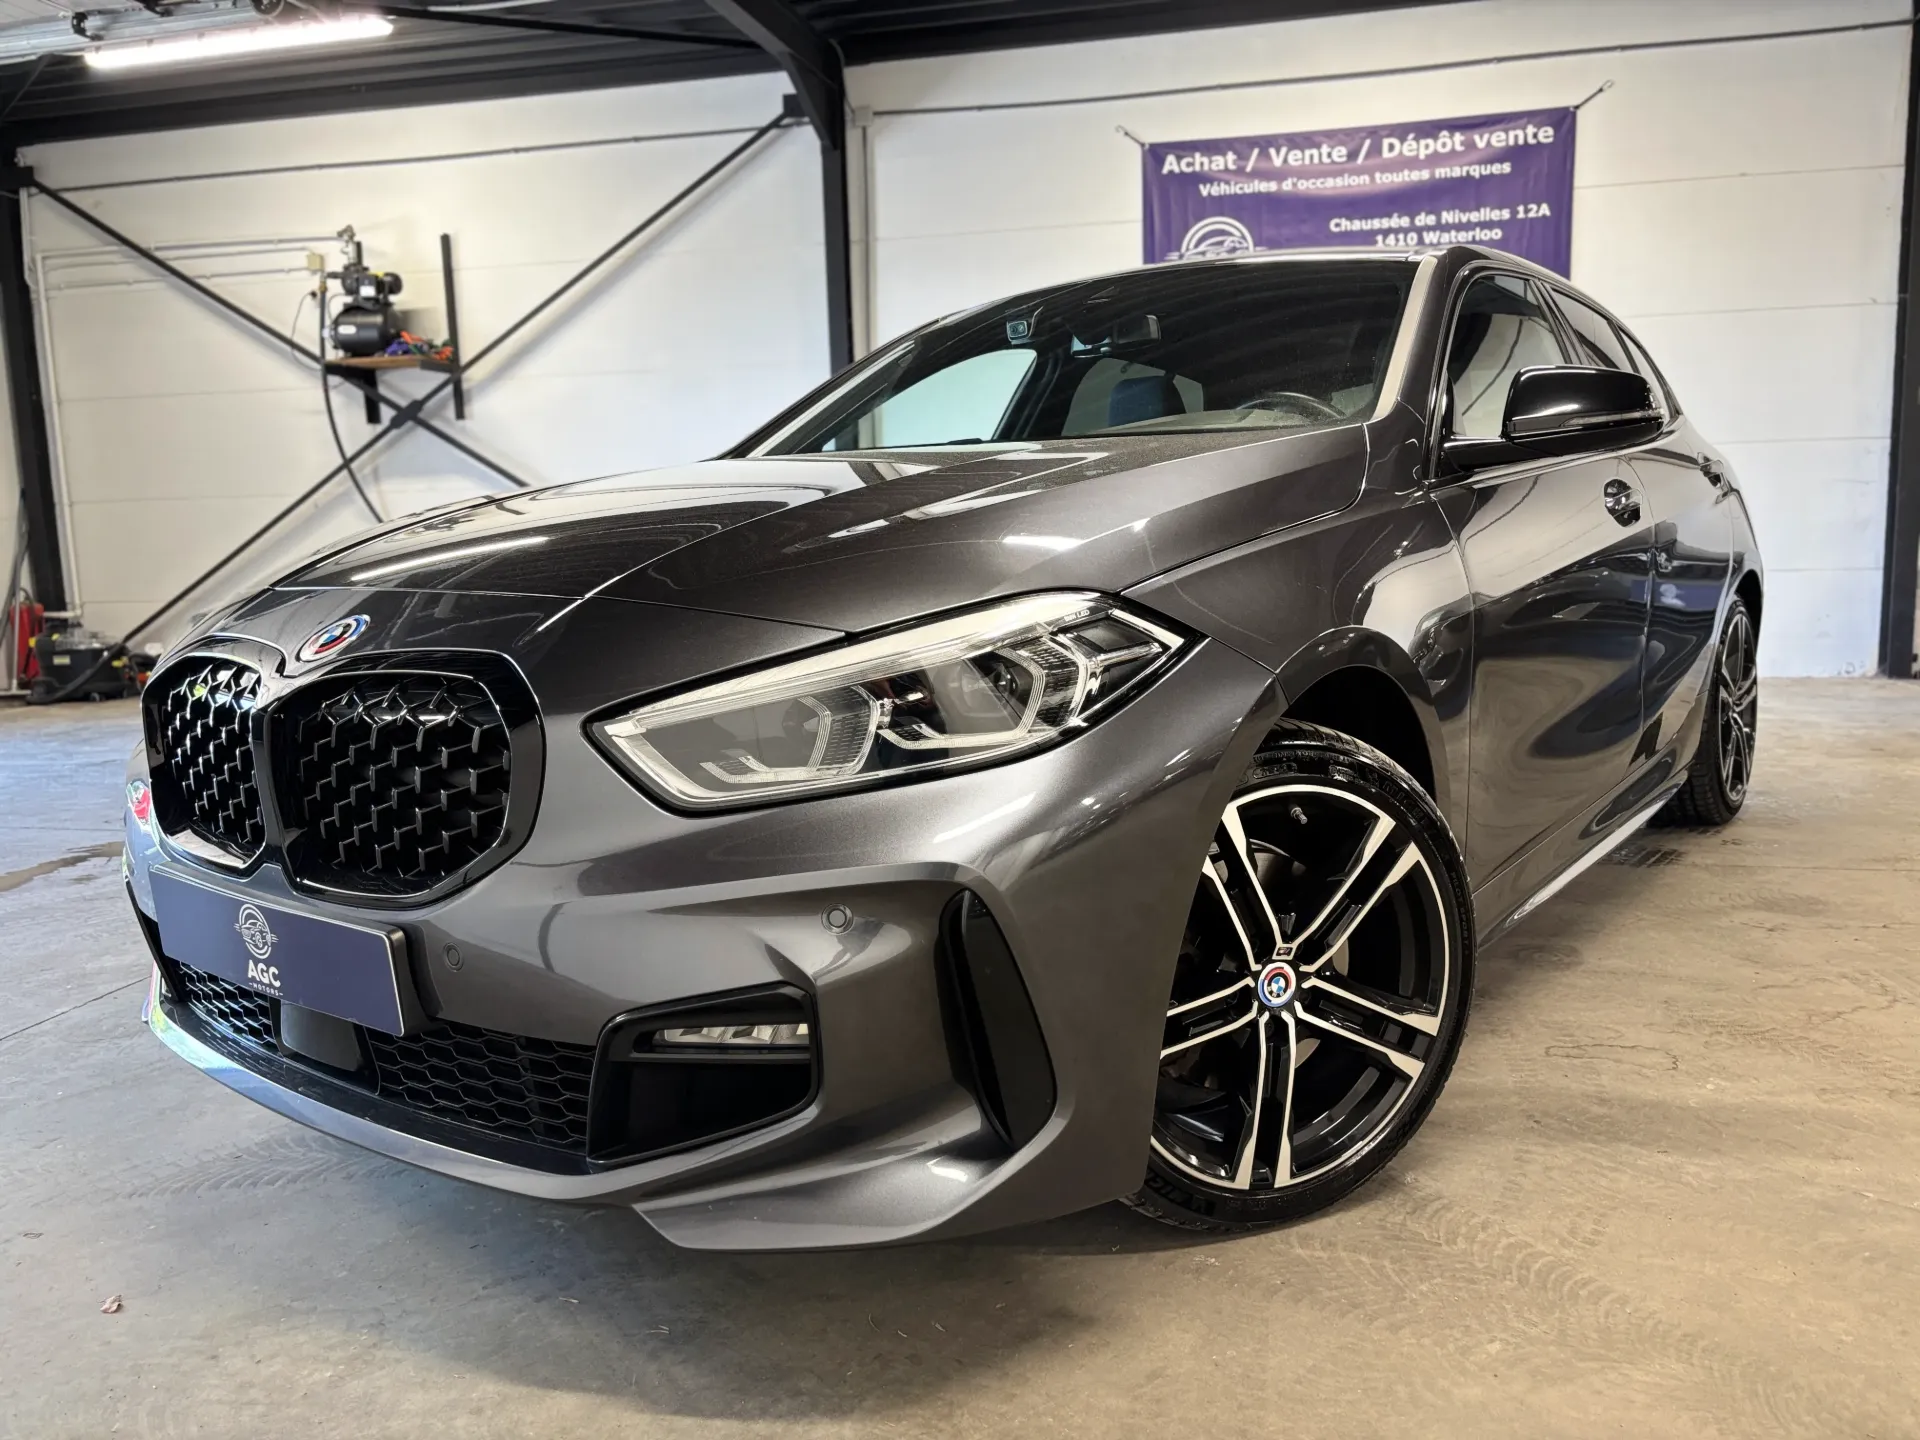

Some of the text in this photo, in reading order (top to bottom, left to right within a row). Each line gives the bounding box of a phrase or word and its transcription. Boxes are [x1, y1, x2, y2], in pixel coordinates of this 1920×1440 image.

[1161, 124, 1555, 175] Achat / Vente / Dépôt vente
[1199, 161, 1512, 198] Véhicules d'occasion toutes marques
[1329, 202, 1551, 233] Chaussée de Nivelles 12A
[1375, 226, 1503, 247] 1410 Waterloo
[1077, 609, 1090, 618] LED
[247, 959, 281, 988] AGC
